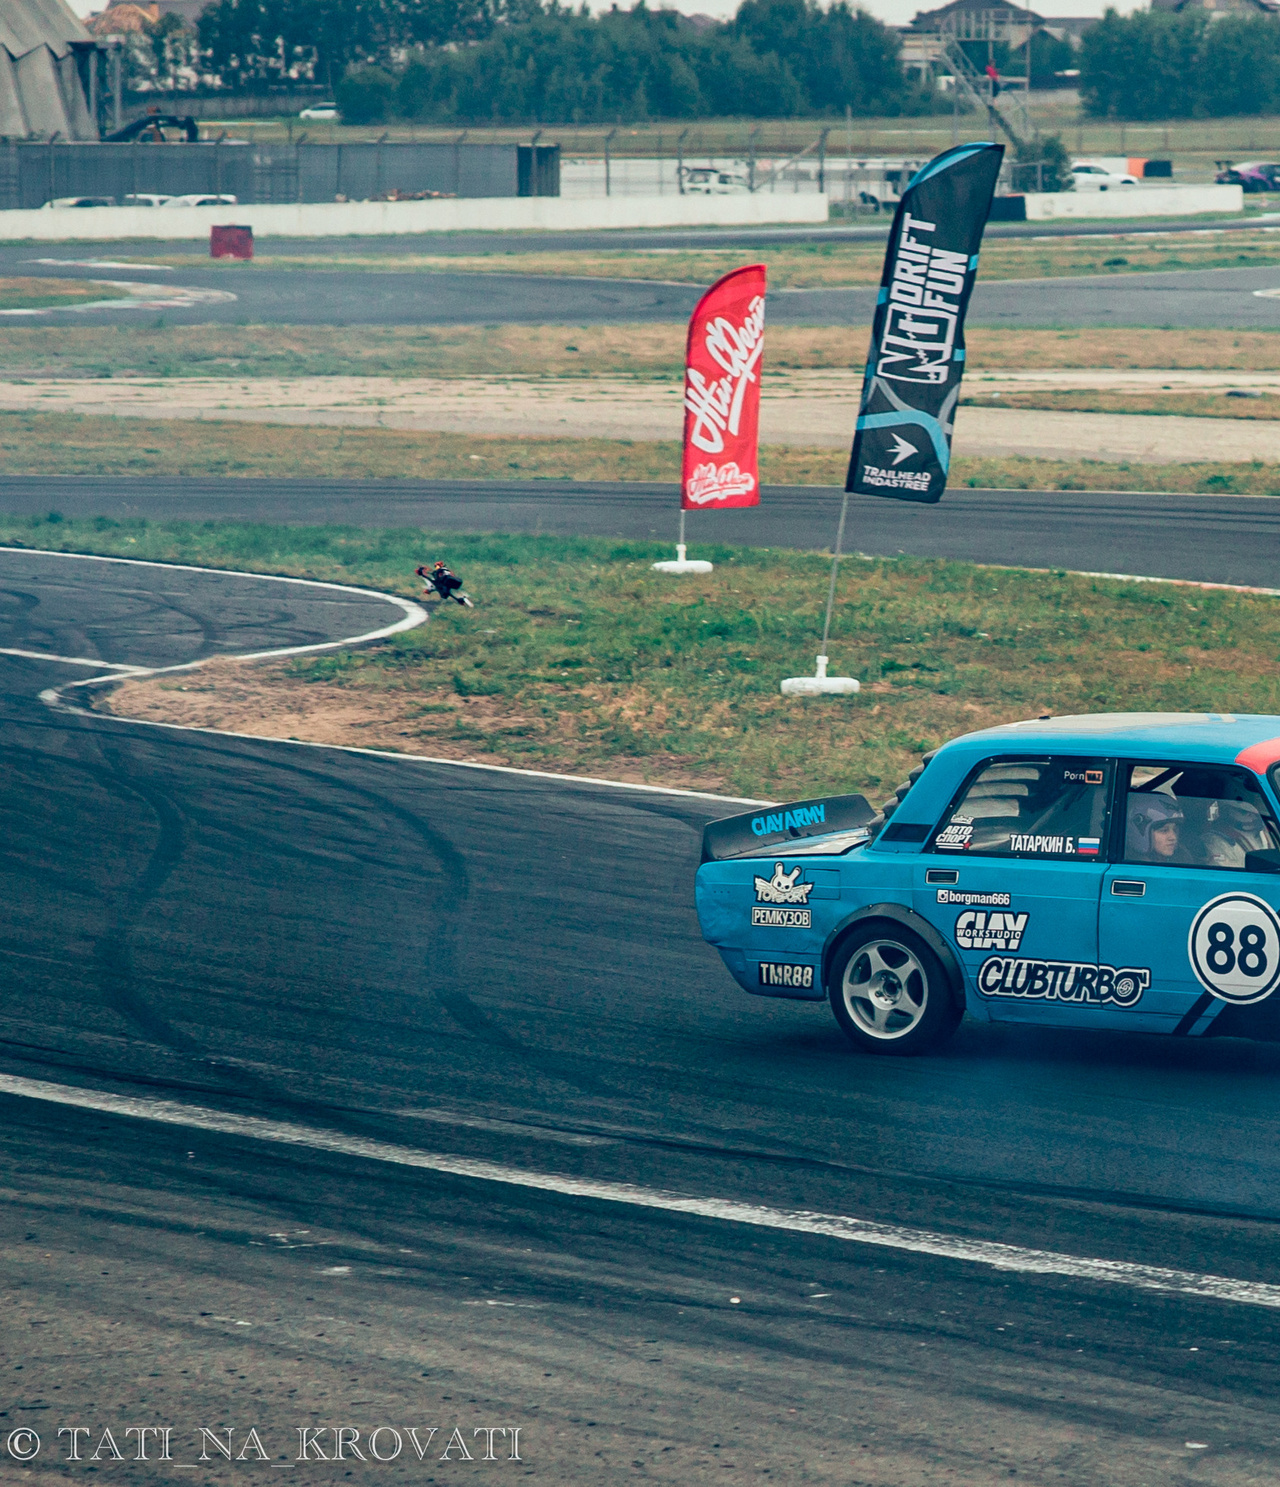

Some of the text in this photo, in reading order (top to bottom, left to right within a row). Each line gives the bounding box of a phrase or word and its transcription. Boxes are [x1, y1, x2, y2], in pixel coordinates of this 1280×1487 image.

[890, 212, 936, 305] DRIFT
[923, 248, 968, 313] FUN
[863, 465, 931, 481] TRAILHEAD
[862, 475, 929, 491] INDASTREE
[935, 833, 973, 844] СПОРТ
[943, 825, 974, 835] АВТО
[1010, 834, 1076, 854] ТАТАРКИН Б.
[949, 890, 1010, 906] borgman666
[754, 909, 809, 927] РЕМКУЗОВ
[1206, 921, 1267, 978] 88
[761, 963, 813, 987] TMR88
[979, 957, 1150, 1006] CLUBTURBO
